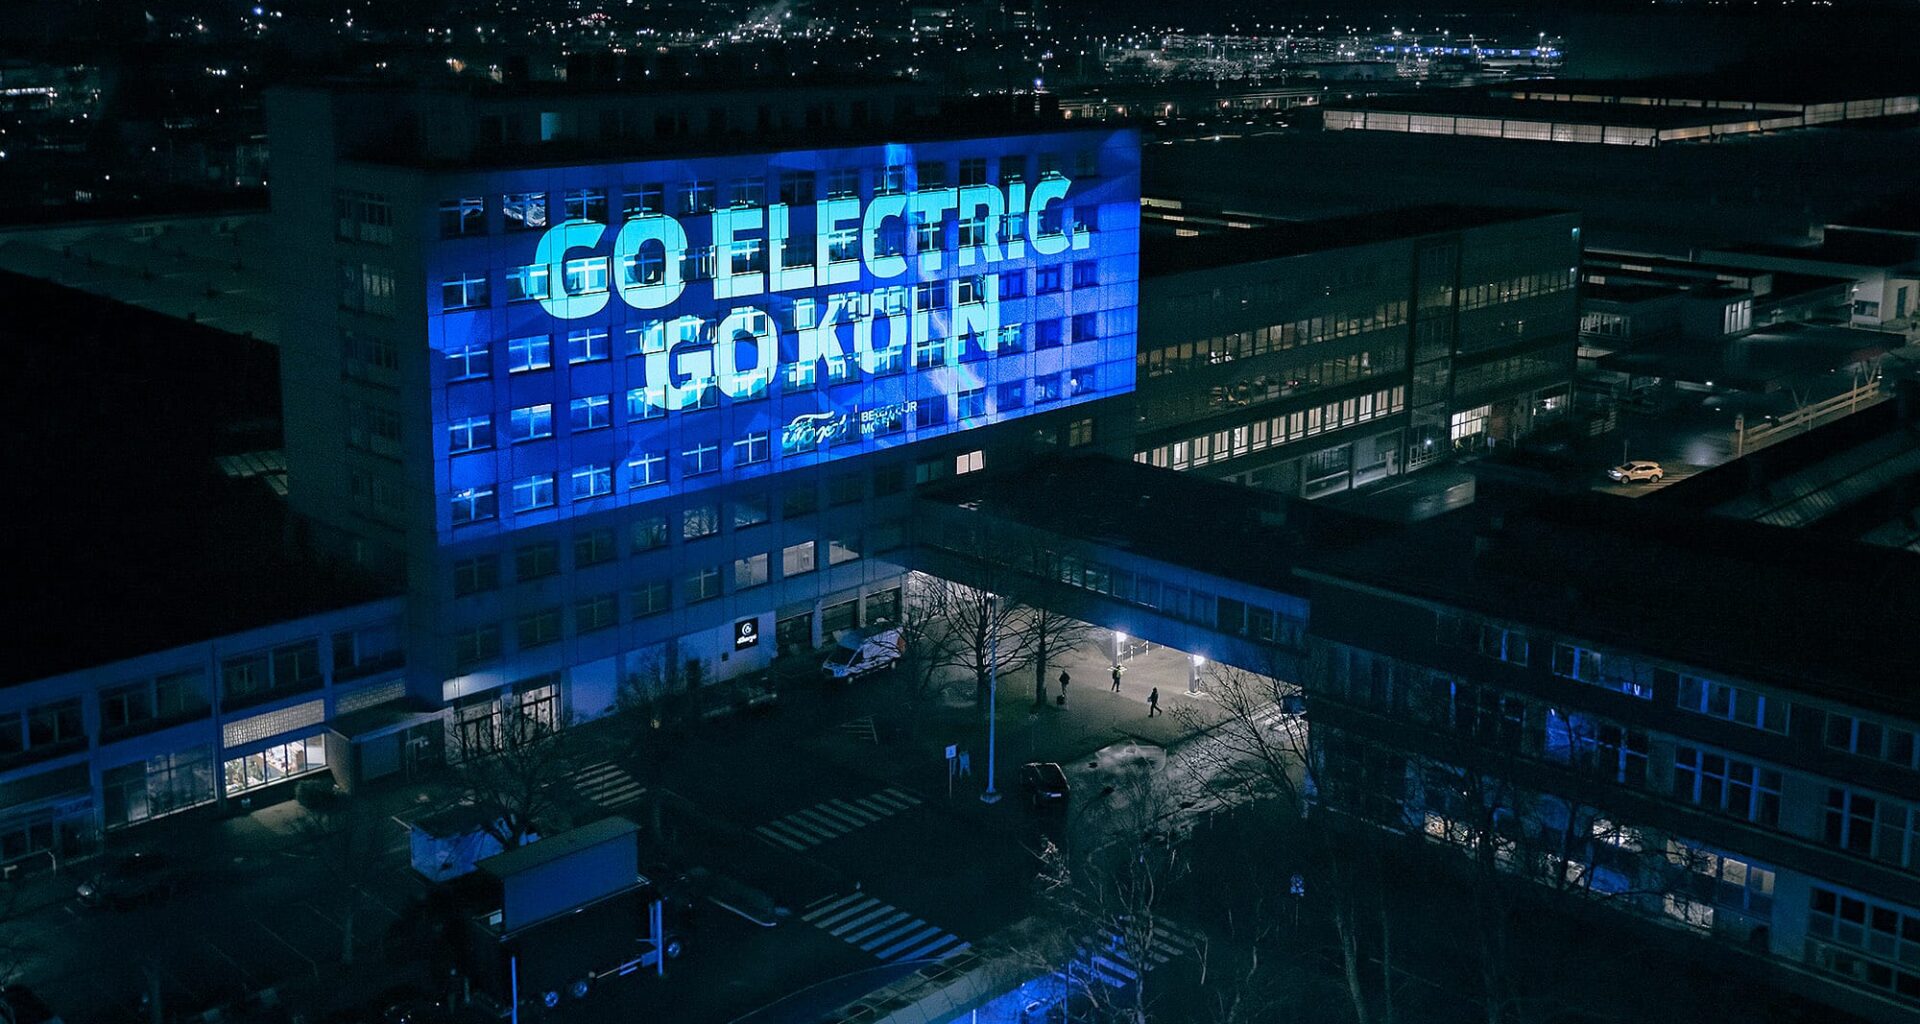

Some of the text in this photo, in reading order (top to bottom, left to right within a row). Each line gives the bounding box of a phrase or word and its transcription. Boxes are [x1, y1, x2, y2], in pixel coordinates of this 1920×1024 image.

[535, 171, 1090, 319] GO ELECTRIC.
[642, 306, 779, 411] GO
